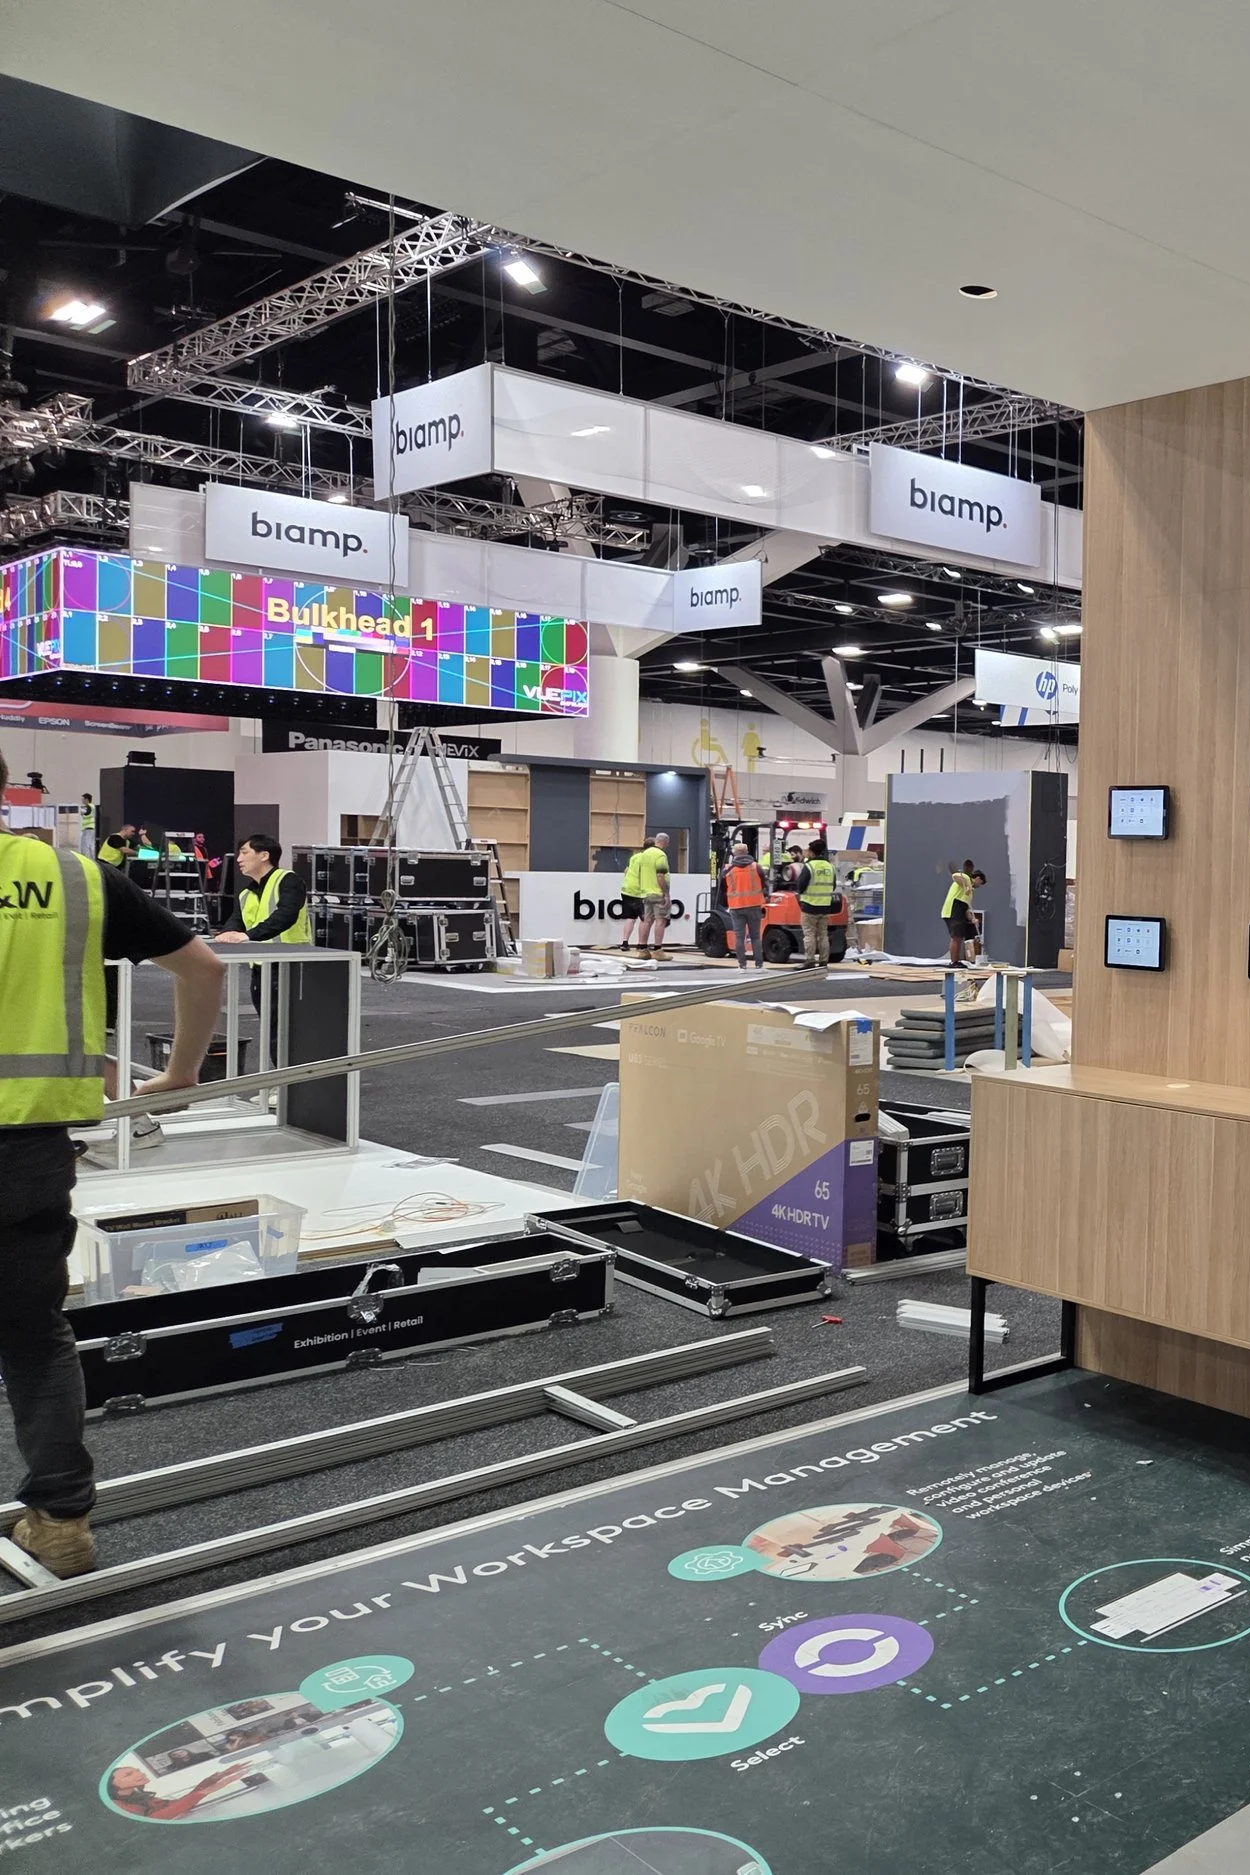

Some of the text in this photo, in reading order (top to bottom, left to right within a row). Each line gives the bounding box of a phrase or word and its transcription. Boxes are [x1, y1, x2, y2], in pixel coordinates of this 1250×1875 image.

[396, 413, 464, 455] biamp.
[910, 478, 1007, 533] biamp.
[251, 511, 369, 557] biamp.
[690, 586, 742, 609] biamp.
[267, 597, 433, 641] Bulkhead 1
[1037, 671, 1079, 700] hp Poly
[38, 716, 70, 726] EPSON
[288, 731, 404, 755] Panasonic
[856, 1083, 870, 1095] 65
[732, 1089, 827, 1196] HDR
[814, 1180, 830, 1200] 65
[294, 1331, 349, 1349] Exhibition
[356, 1324, 386, 1338] Event
[393, 1316, 424, 1330] Retail
[906, 1452, 1037, 1496] Remotely manage,
[923, 1450, 1067, 1503] configure and update
[935, 1465, 1052, 1508] video conference
[952, 1478, 1042, 1514] and personal
[965, 1471, 1092, 1519] workspace devices
[246, 1593, 392, 1650] your
[401, 1498, 713, 1593] Workspace
[713, 1409, 999, 1499] Management
[758, 1611, 808, 1632] Sync
[730, 1735, 806, 1772] Select
